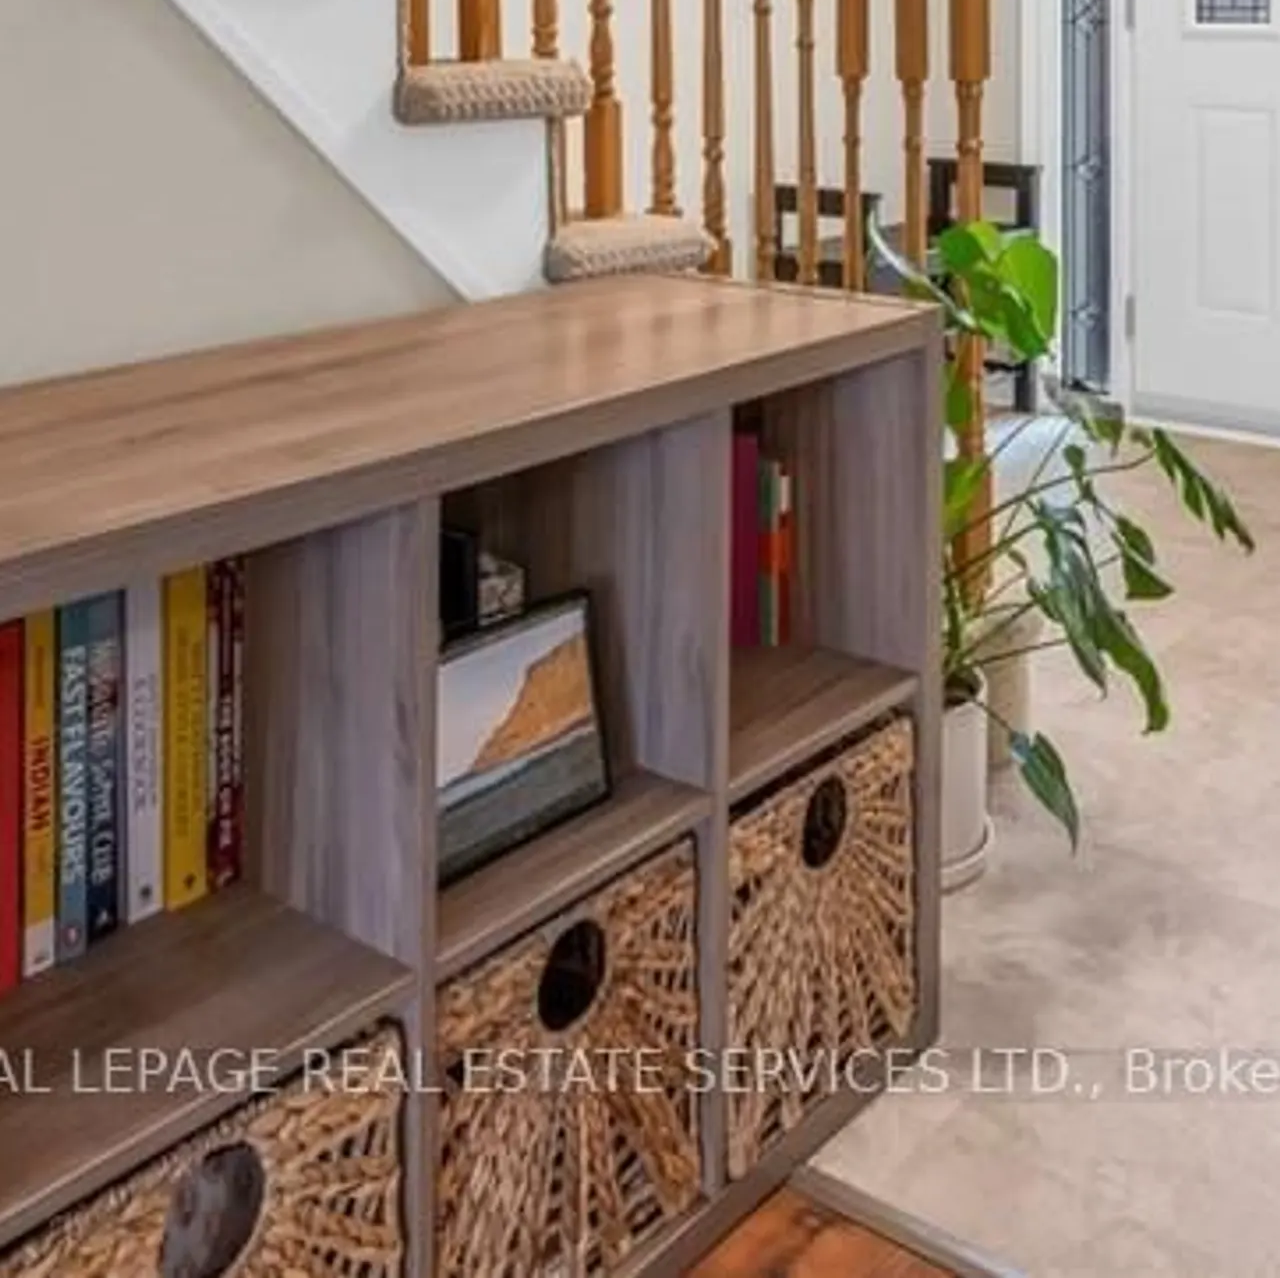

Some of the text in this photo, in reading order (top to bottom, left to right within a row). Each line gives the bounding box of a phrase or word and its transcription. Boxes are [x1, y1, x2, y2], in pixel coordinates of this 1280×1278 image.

[29, 734, 52, 832] INDIAN
[61, 644, 85, 886] FAST FLAVOURS
